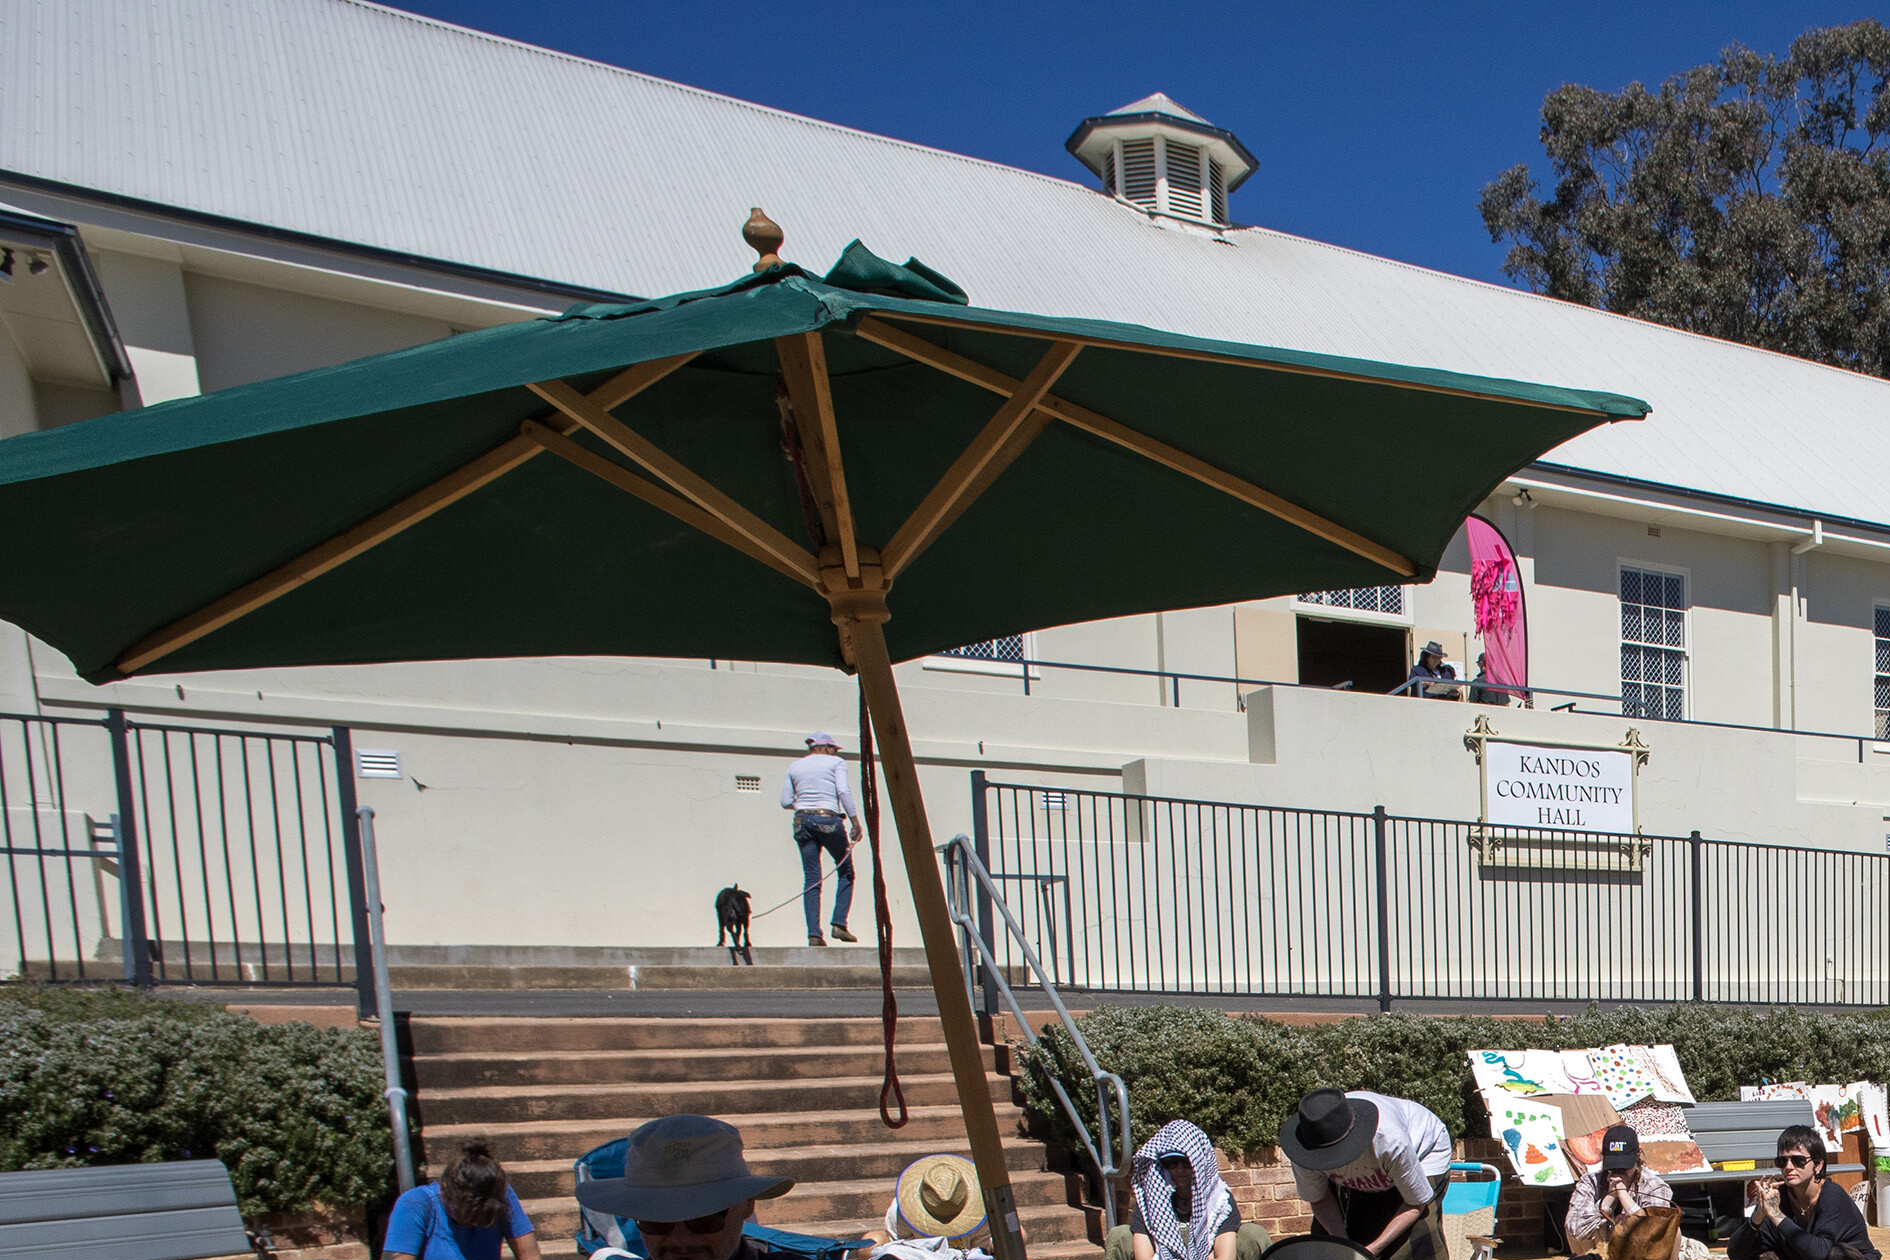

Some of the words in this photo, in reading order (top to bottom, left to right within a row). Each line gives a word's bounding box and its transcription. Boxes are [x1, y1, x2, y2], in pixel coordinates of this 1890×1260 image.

[1520, 755, 1600, 778] KANDOS
[1496, 780, 1623, 804] COMMUNITY
[1538, 807, 1586, 826] HALL
[1610, 1141, 1624, 1151] CAT
